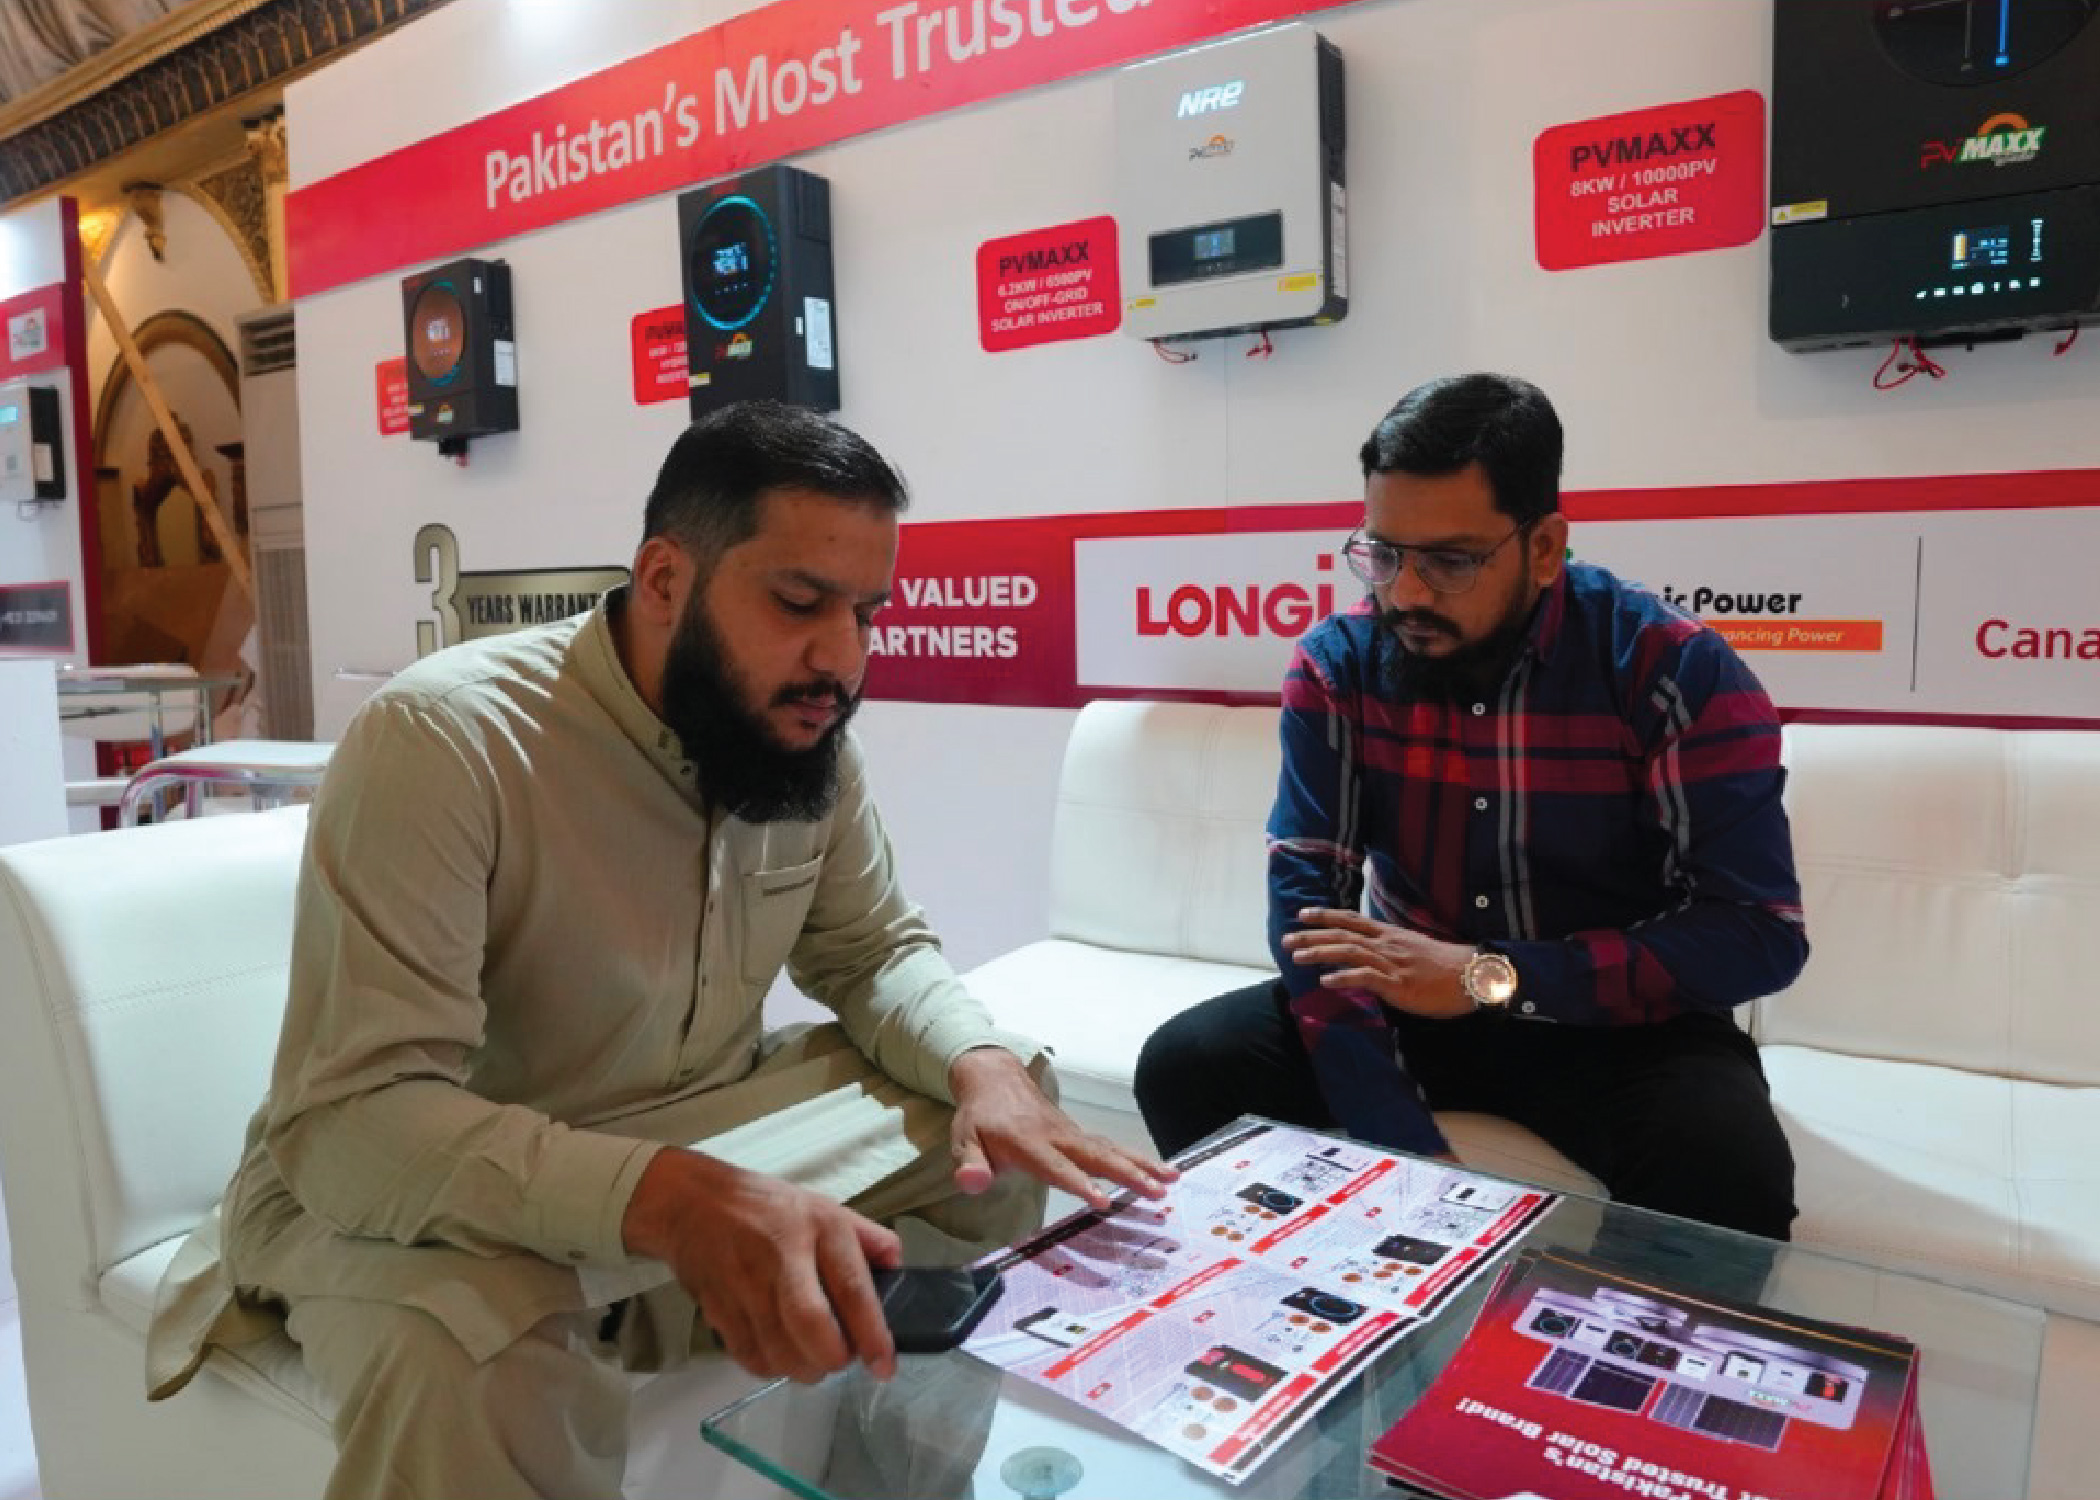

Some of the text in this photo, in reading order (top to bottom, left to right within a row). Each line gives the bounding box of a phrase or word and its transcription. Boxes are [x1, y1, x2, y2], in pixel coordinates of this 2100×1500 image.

[485, 0, 1150, 210] Pakistan's Most Truste
[1570, 123, 1716, 172] PVMAXX
[1619, 173, 1627, 189] /
[1607, 188, 1679, 213] SOLAR
[1591, 207, 1695, 237] INVERTER
[999, 239, 1088, 277] PVMAXX
[991, 302, 1104, 332] SOLAR INVERTER
[414, 523, 602, 658] 3 YEARS WARRANT
[898, 576, 1038, 607] VALUED
[1693, 586, 1803, 614] Power
[867, 625, 1018, 657] ARTNERS
[1721, 626, 1846, 647] ancing Power
[1455, 1396, 1544, 1440] Brand!
[1546, 1431, 1620, 1467] Solar
